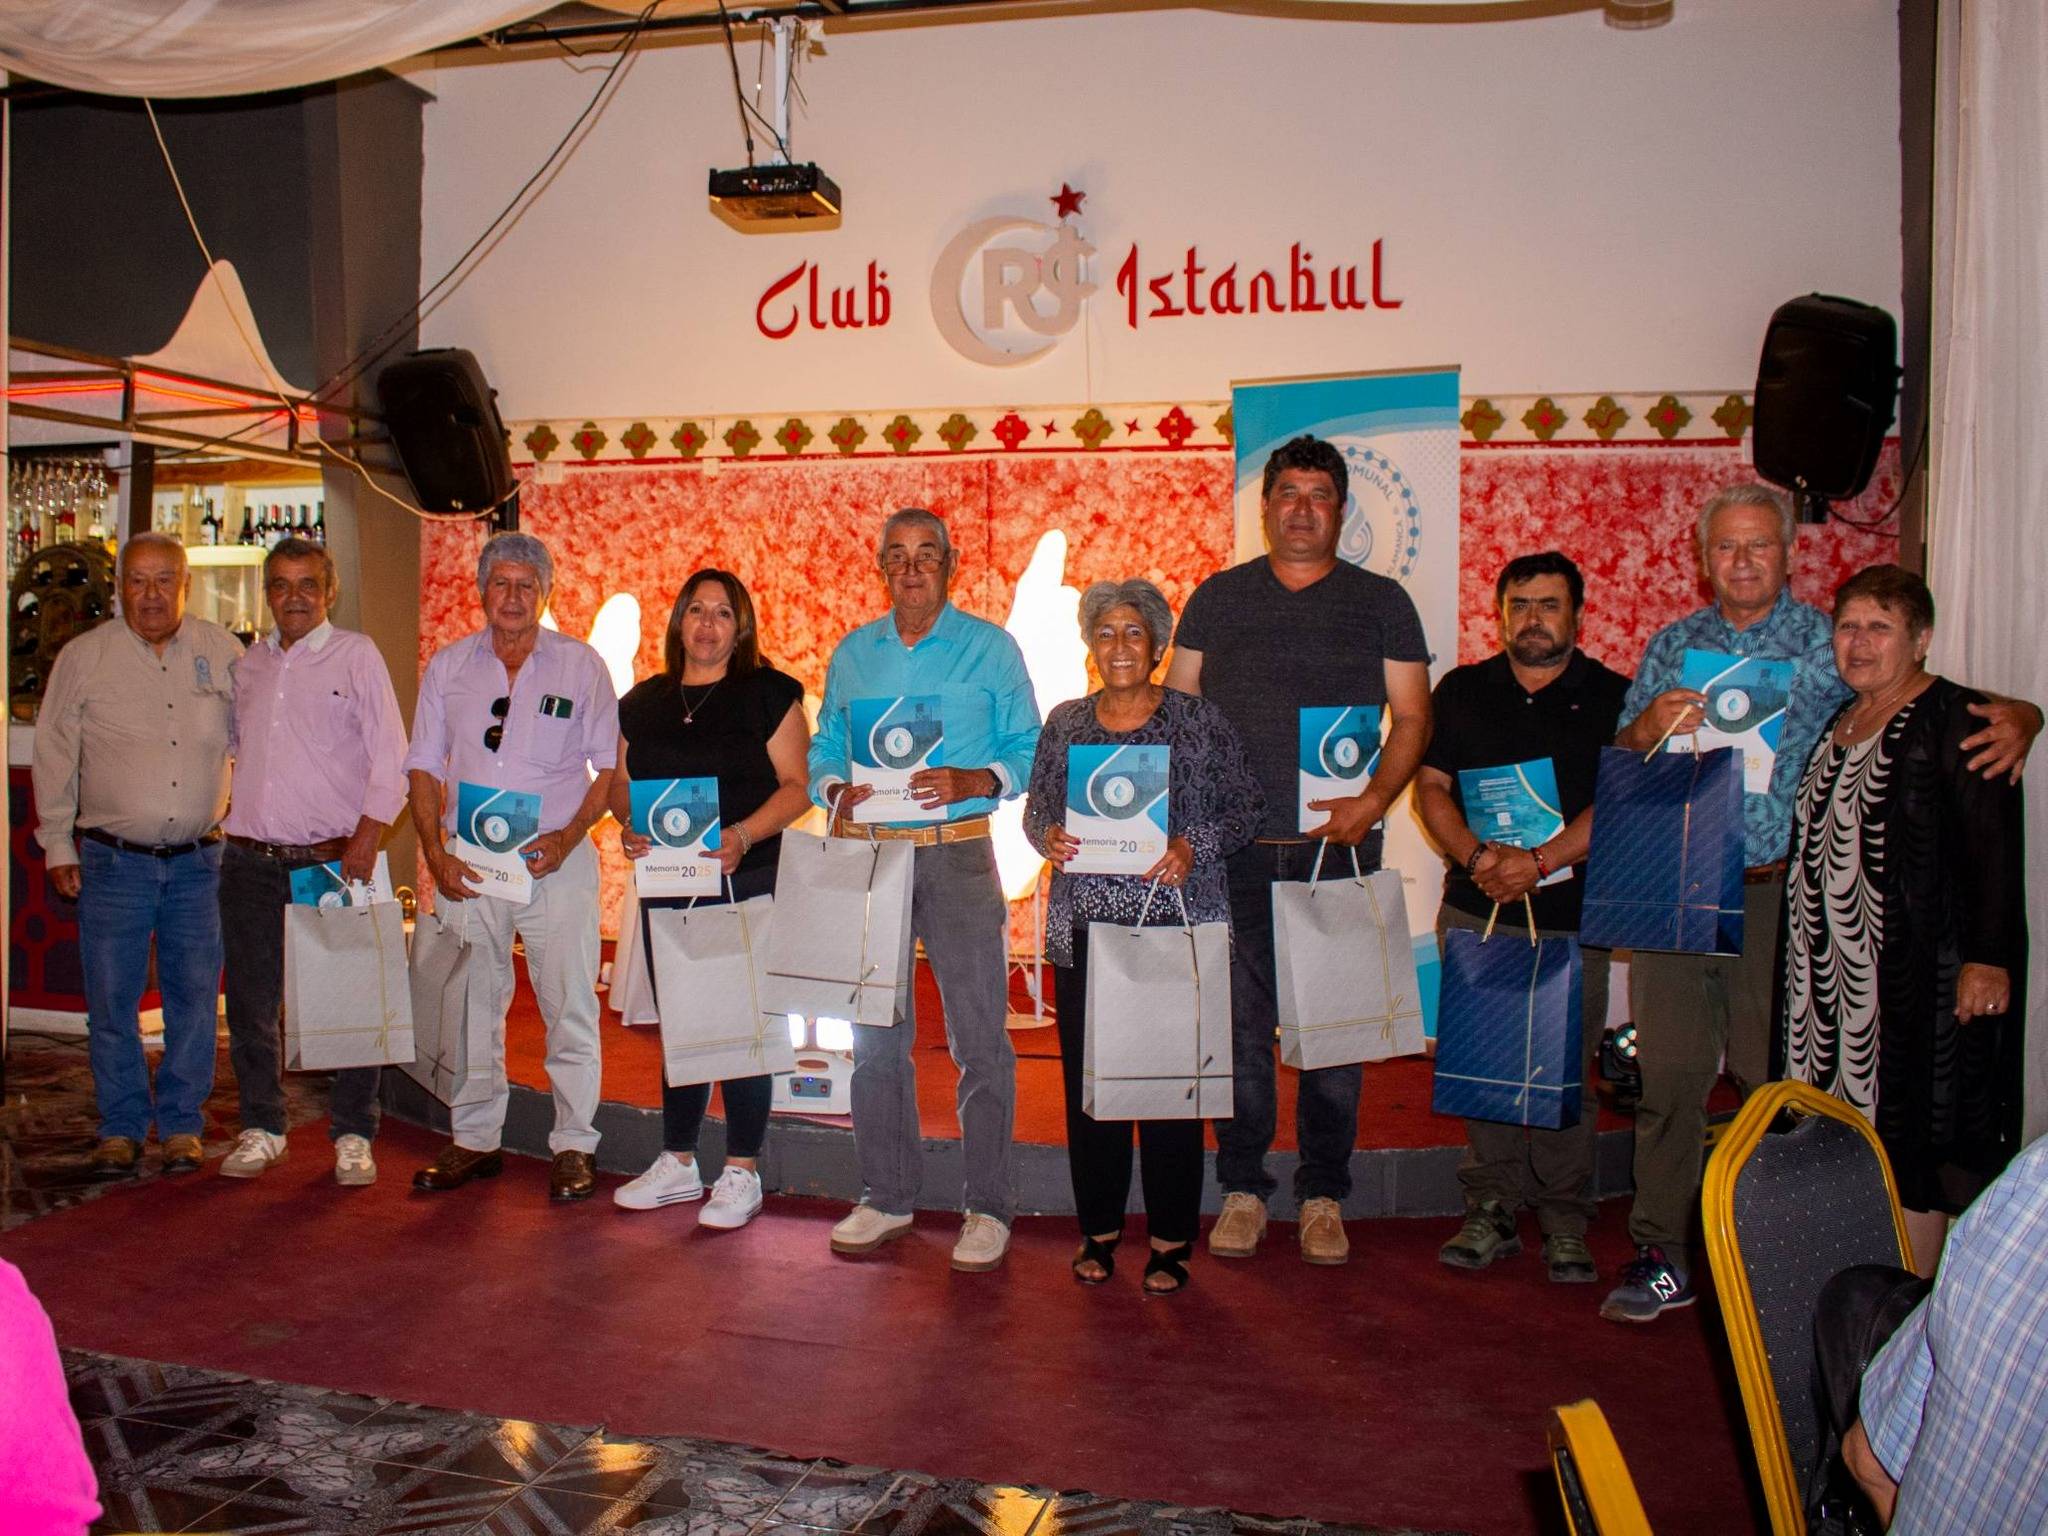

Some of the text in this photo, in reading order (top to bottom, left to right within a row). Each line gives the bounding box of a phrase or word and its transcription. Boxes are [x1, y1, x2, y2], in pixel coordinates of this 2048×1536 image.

[756, 237, 1404, 340] Club Istanbul
[1345, 462, 1394, 501] OMUNAL
[1119, 840, 1156, 853] 2025
[645, 864, 680, 873] Memoria
[681, 864, 712, 878] 2025
[1650, 1272, 1678, 1302] N
